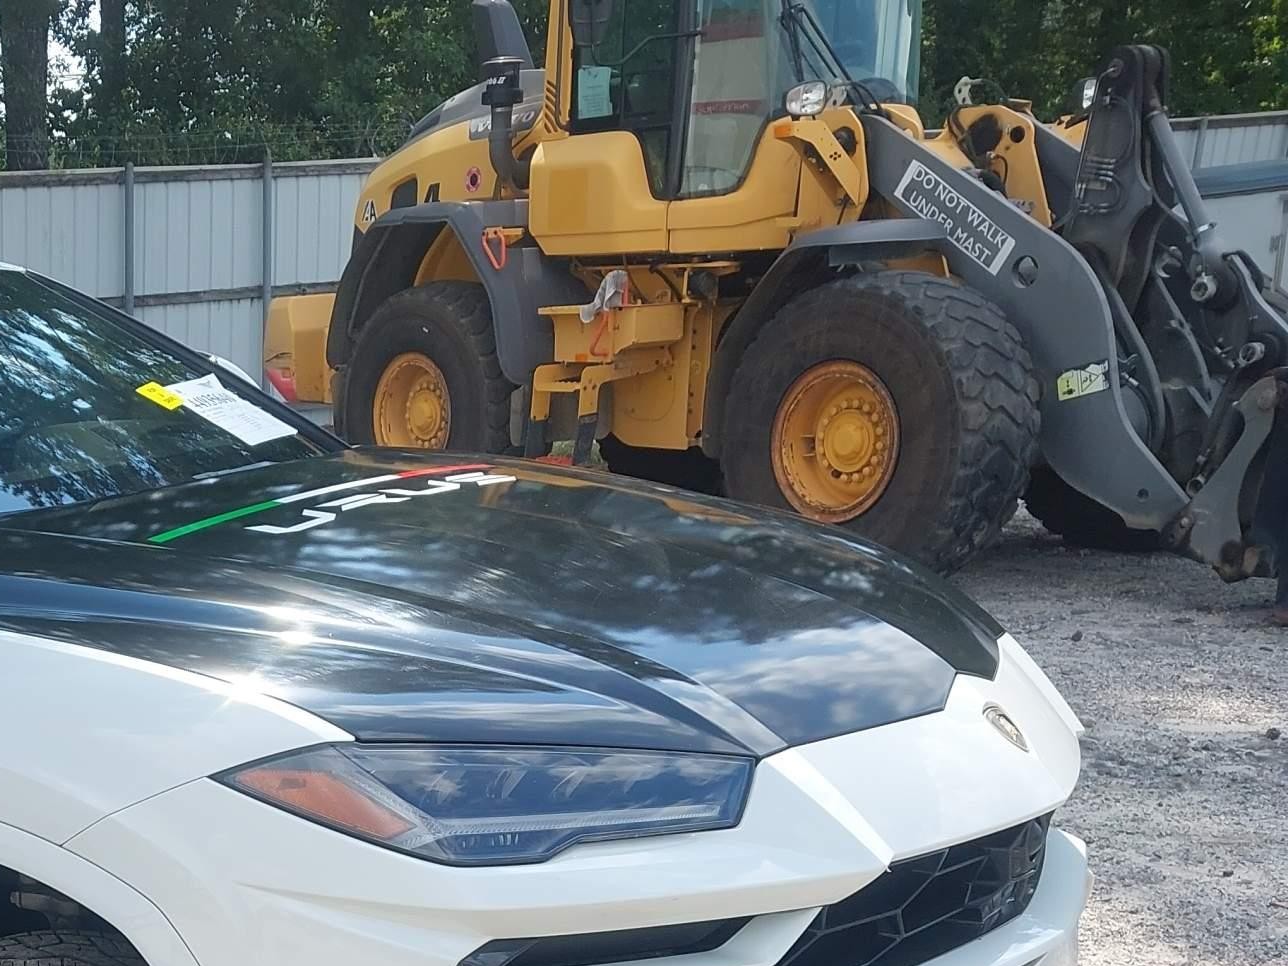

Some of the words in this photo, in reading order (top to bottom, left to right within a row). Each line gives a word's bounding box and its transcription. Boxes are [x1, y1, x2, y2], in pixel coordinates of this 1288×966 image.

[913, 166, 935, 189] DO
[934, 183, 968, 214] NOT
[967, 207, 1008, 248] WALK
[952, 227, 991, 262] MAST
[243, 472, 517, 534] URUS
